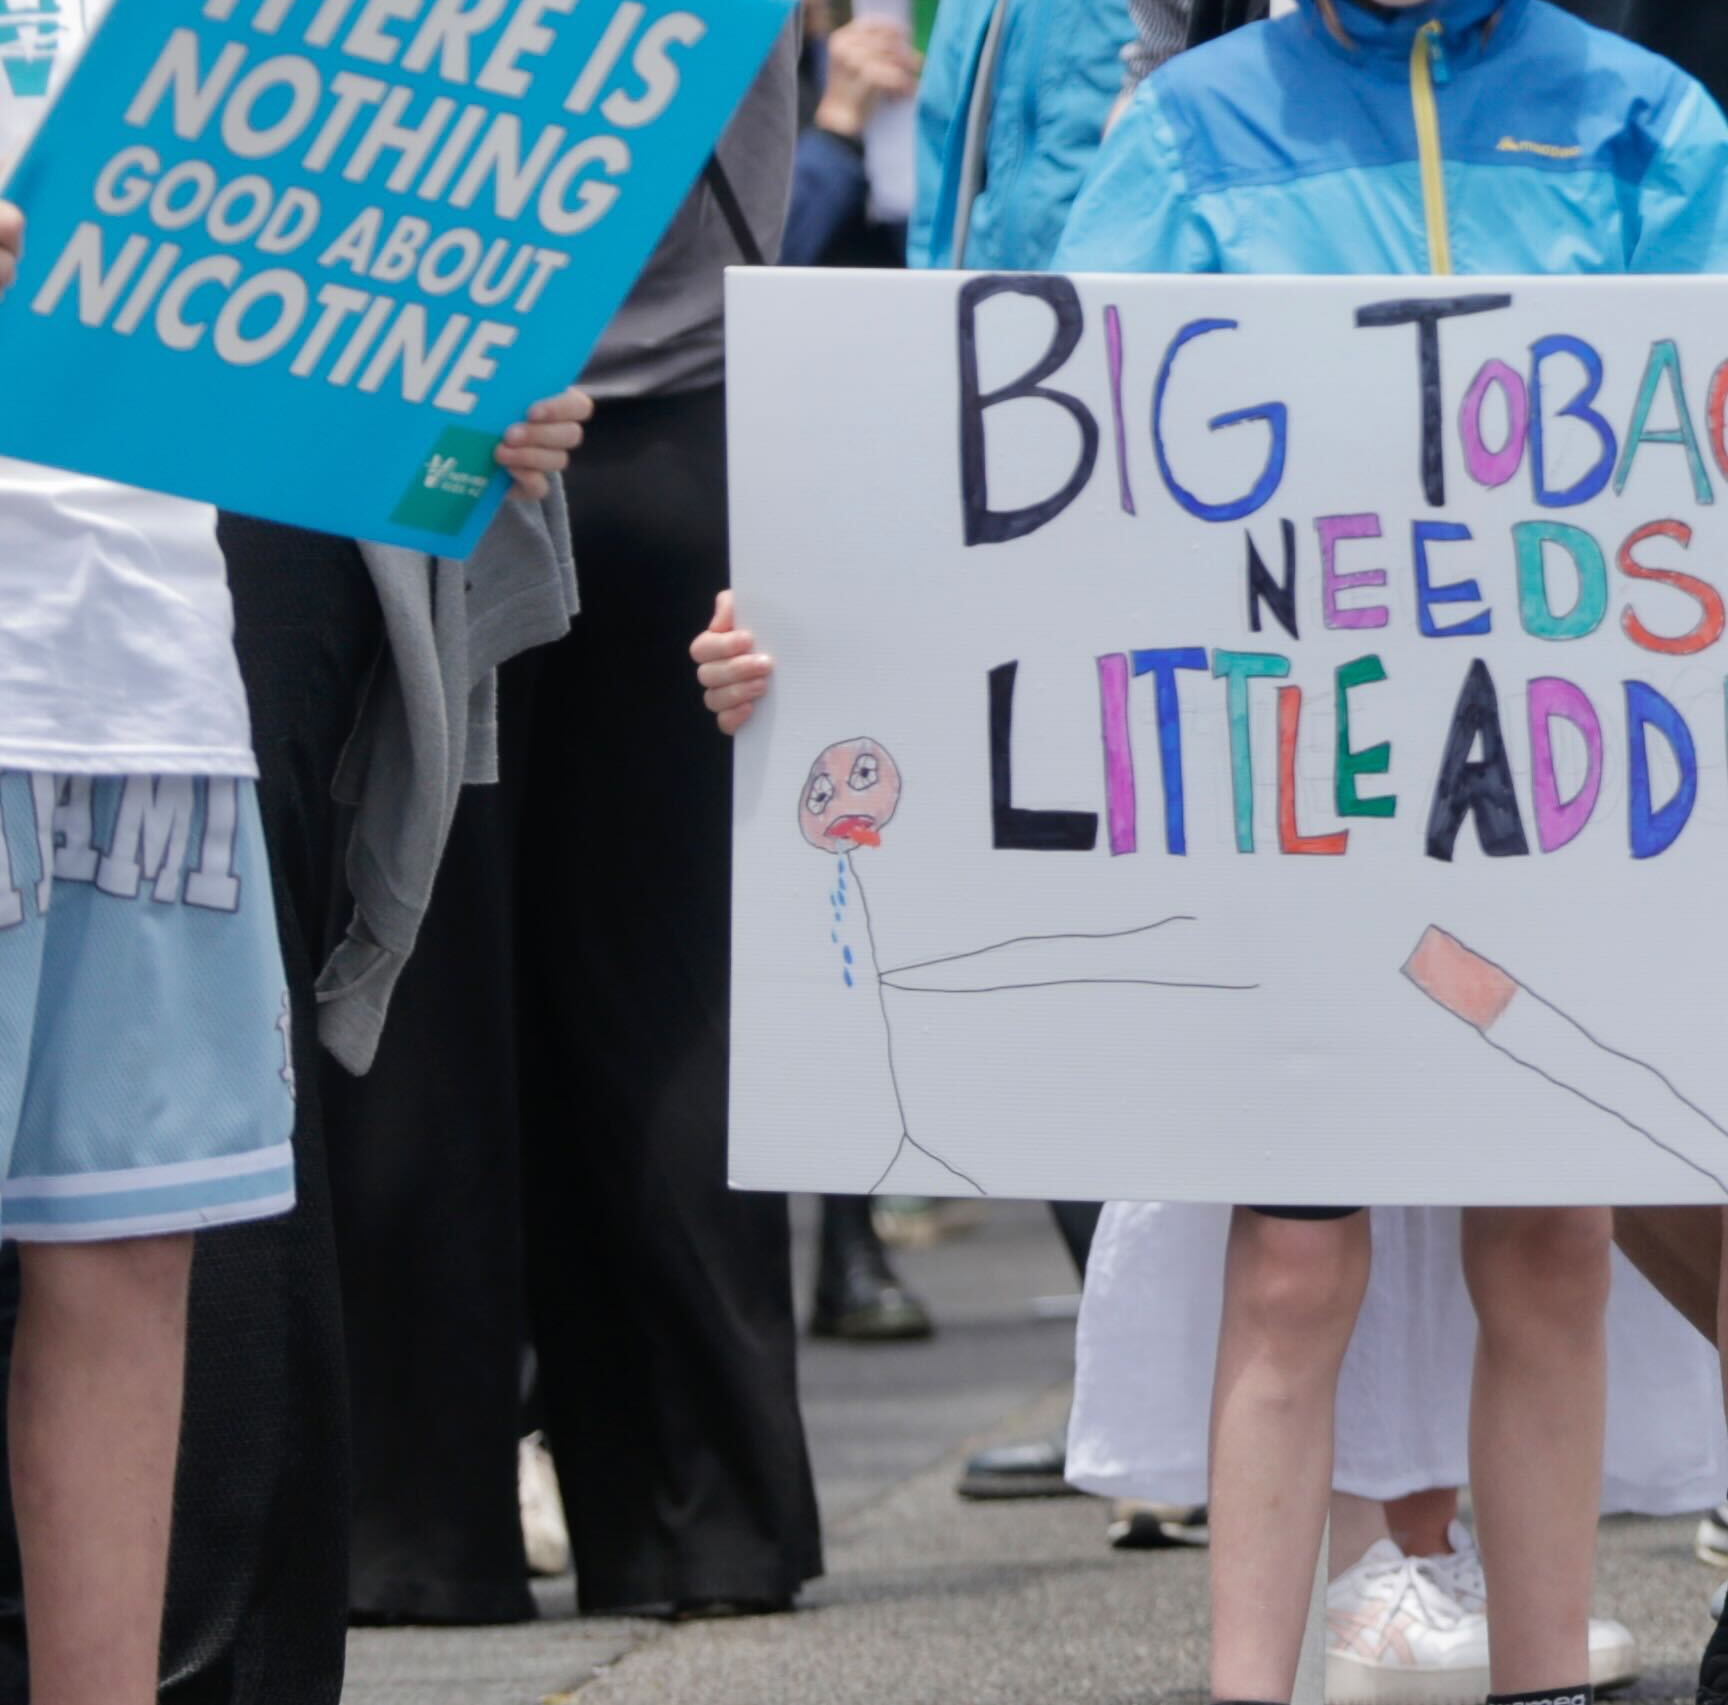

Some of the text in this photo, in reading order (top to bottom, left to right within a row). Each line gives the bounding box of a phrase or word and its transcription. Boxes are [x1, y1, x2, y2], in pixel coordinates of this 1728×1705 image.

[124, 27, 632, 237] NOTHING
[564, 0, 707, 128] IS
[31, 221, 518, 415] NICOTINE
[93, 145, 569, 314] GOOD ABOUT
[957, 274, 1288, 547] BIG
[1245, 513, 1726, 656] NEEDS
[987, 647, 1397, 856] LITTLE
